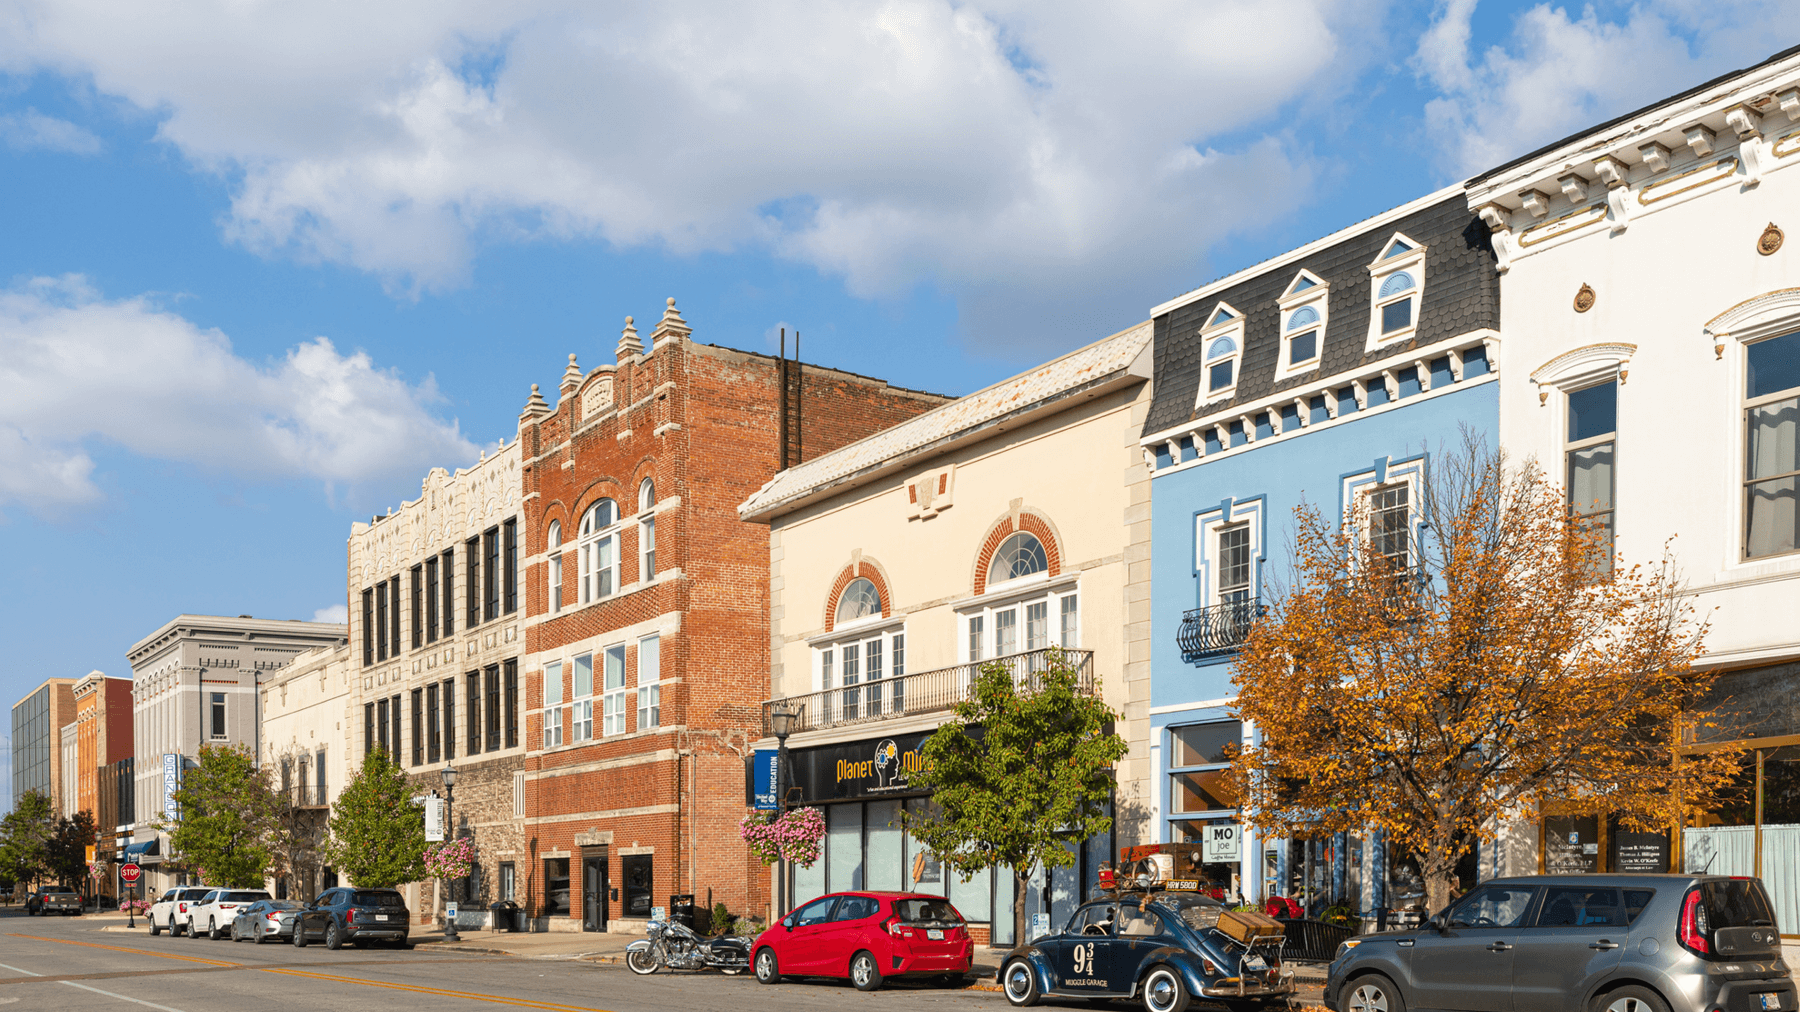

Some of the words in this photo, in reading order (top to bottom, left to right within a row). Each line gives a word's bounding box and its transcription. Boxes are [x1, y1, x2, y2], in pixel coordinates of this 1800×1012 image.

[1214, 828, 1233, 840] MO
[1217, 840, 1230, 852] joe
[1086, 979, 1108, 987] GARAGE
